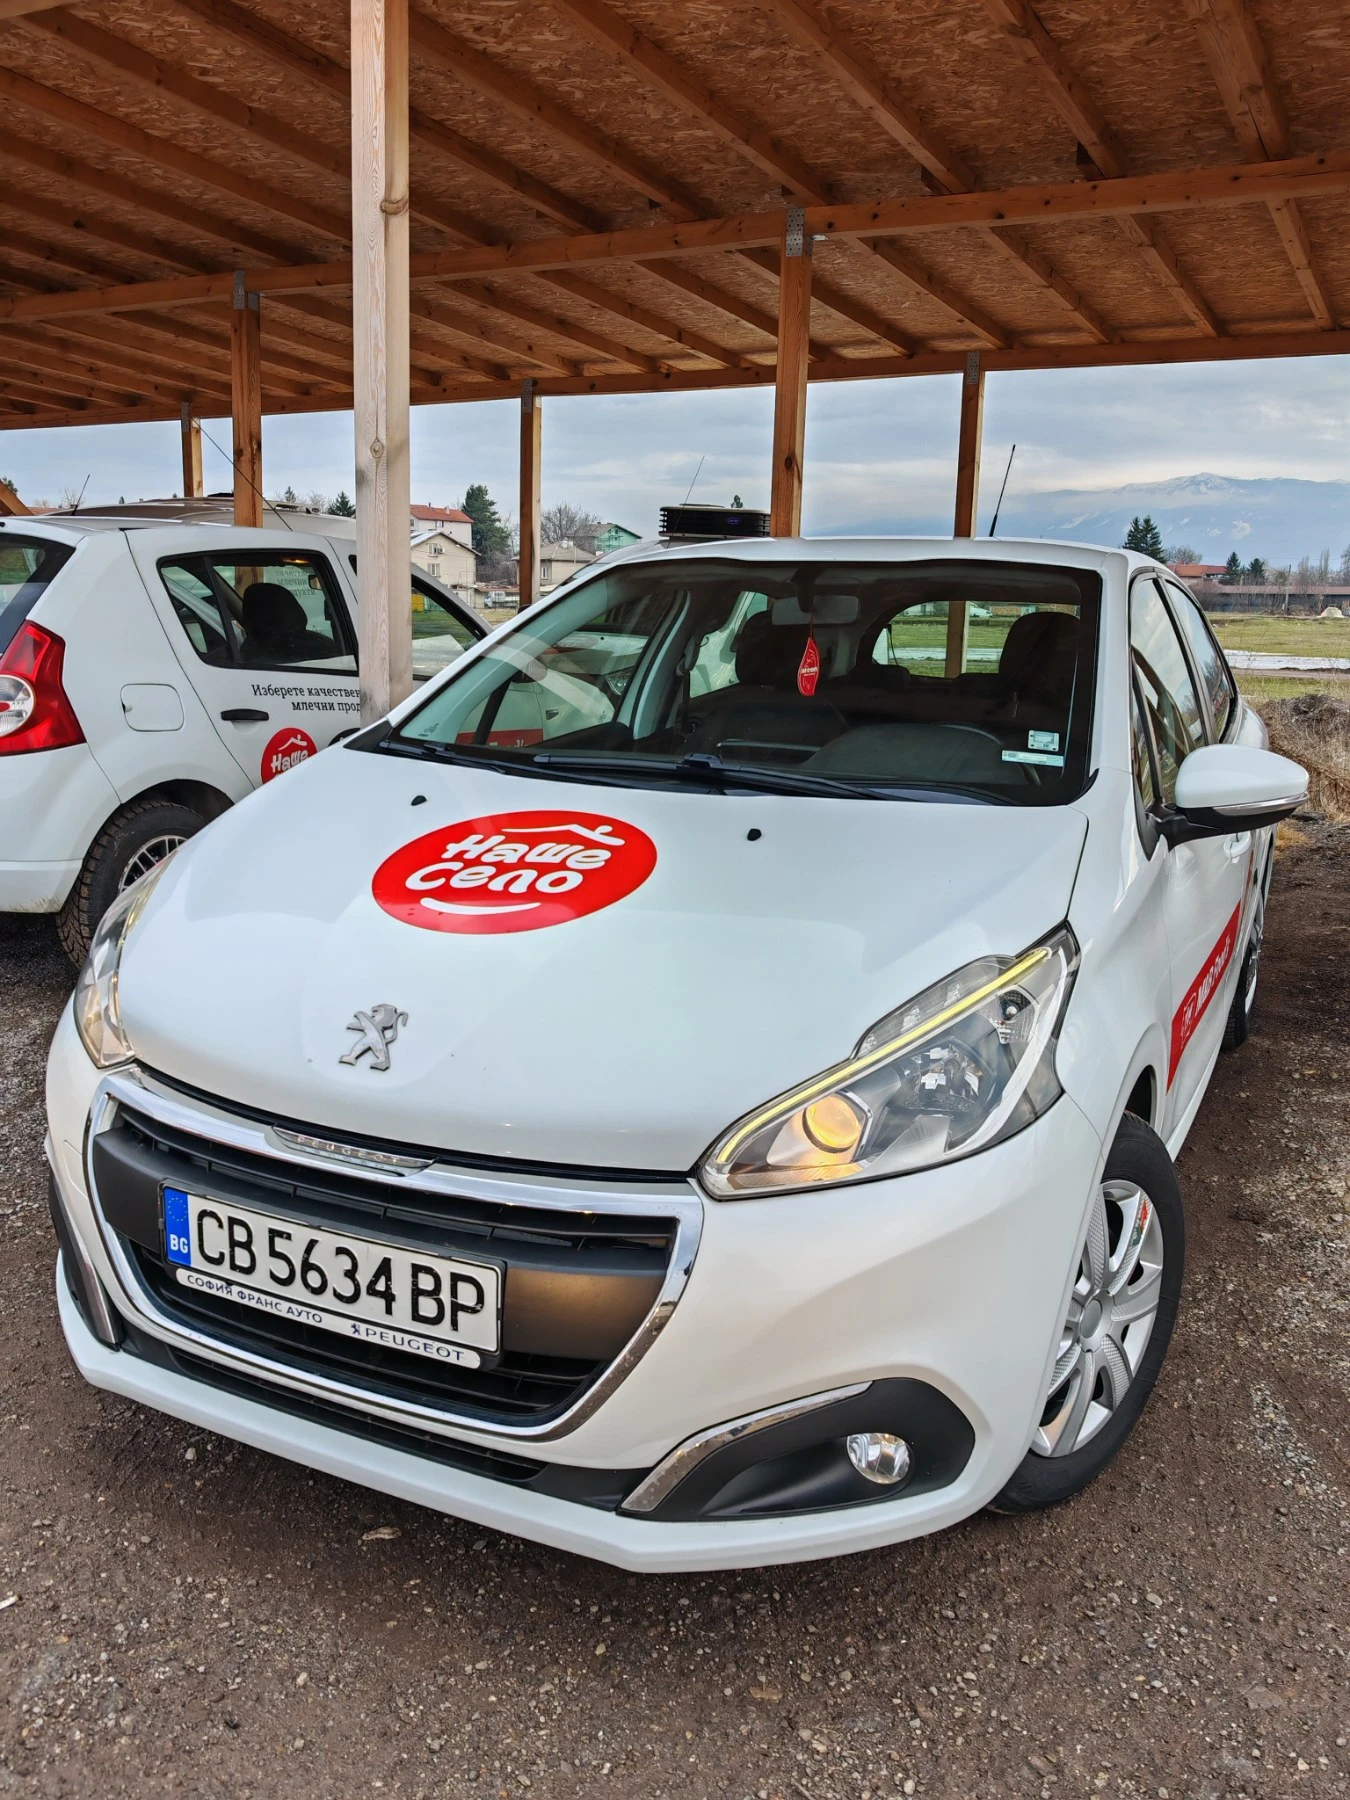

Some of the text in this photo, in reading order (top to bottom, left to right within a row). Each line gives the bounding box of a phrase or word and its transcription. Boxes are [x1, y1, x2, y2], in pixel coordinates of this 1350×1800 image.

[252, 684, 305, 699] Изберете
[291, 701, 335, 711] млечни
[441, 834, 612, 870] Наше
[405, 861, 583, 893] Село
[297, 1136, 400, 1164] PEUGEOT
[169, 1233, 189, 1254] BG
[268, 1229, 396, 1316] 5634
[187, 1275, 323, 1324] СОФИЯ ФРАНС АУТО
[365, 1327, 465, 1361] PEUGEOT
